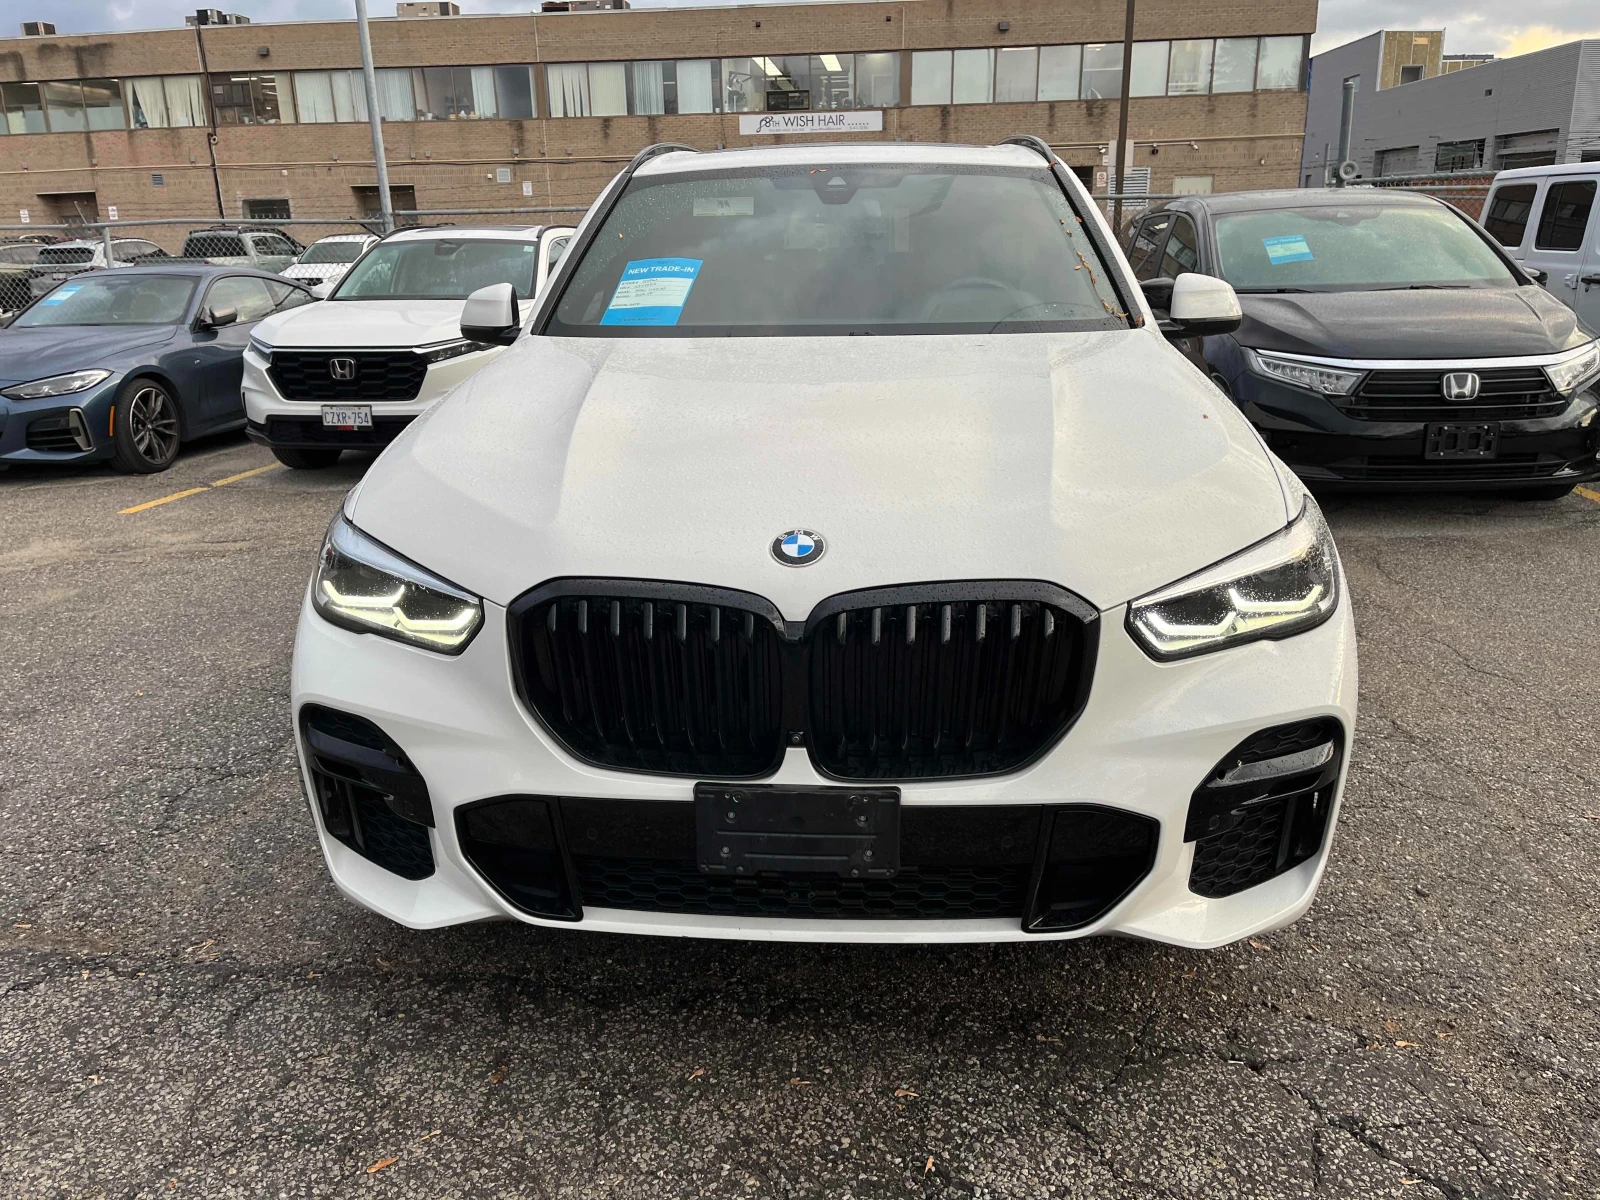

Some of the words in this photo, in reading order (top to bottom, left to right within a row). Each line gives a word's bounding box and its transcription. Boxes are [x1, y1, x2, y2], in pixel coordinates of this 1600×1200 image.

[782, 115, 815, 127] WISH
[817, 114, 846, 126] HAIR
[628, 266, 650, 275] NEW
[650, 265, 695, 273] TRADE-IN
